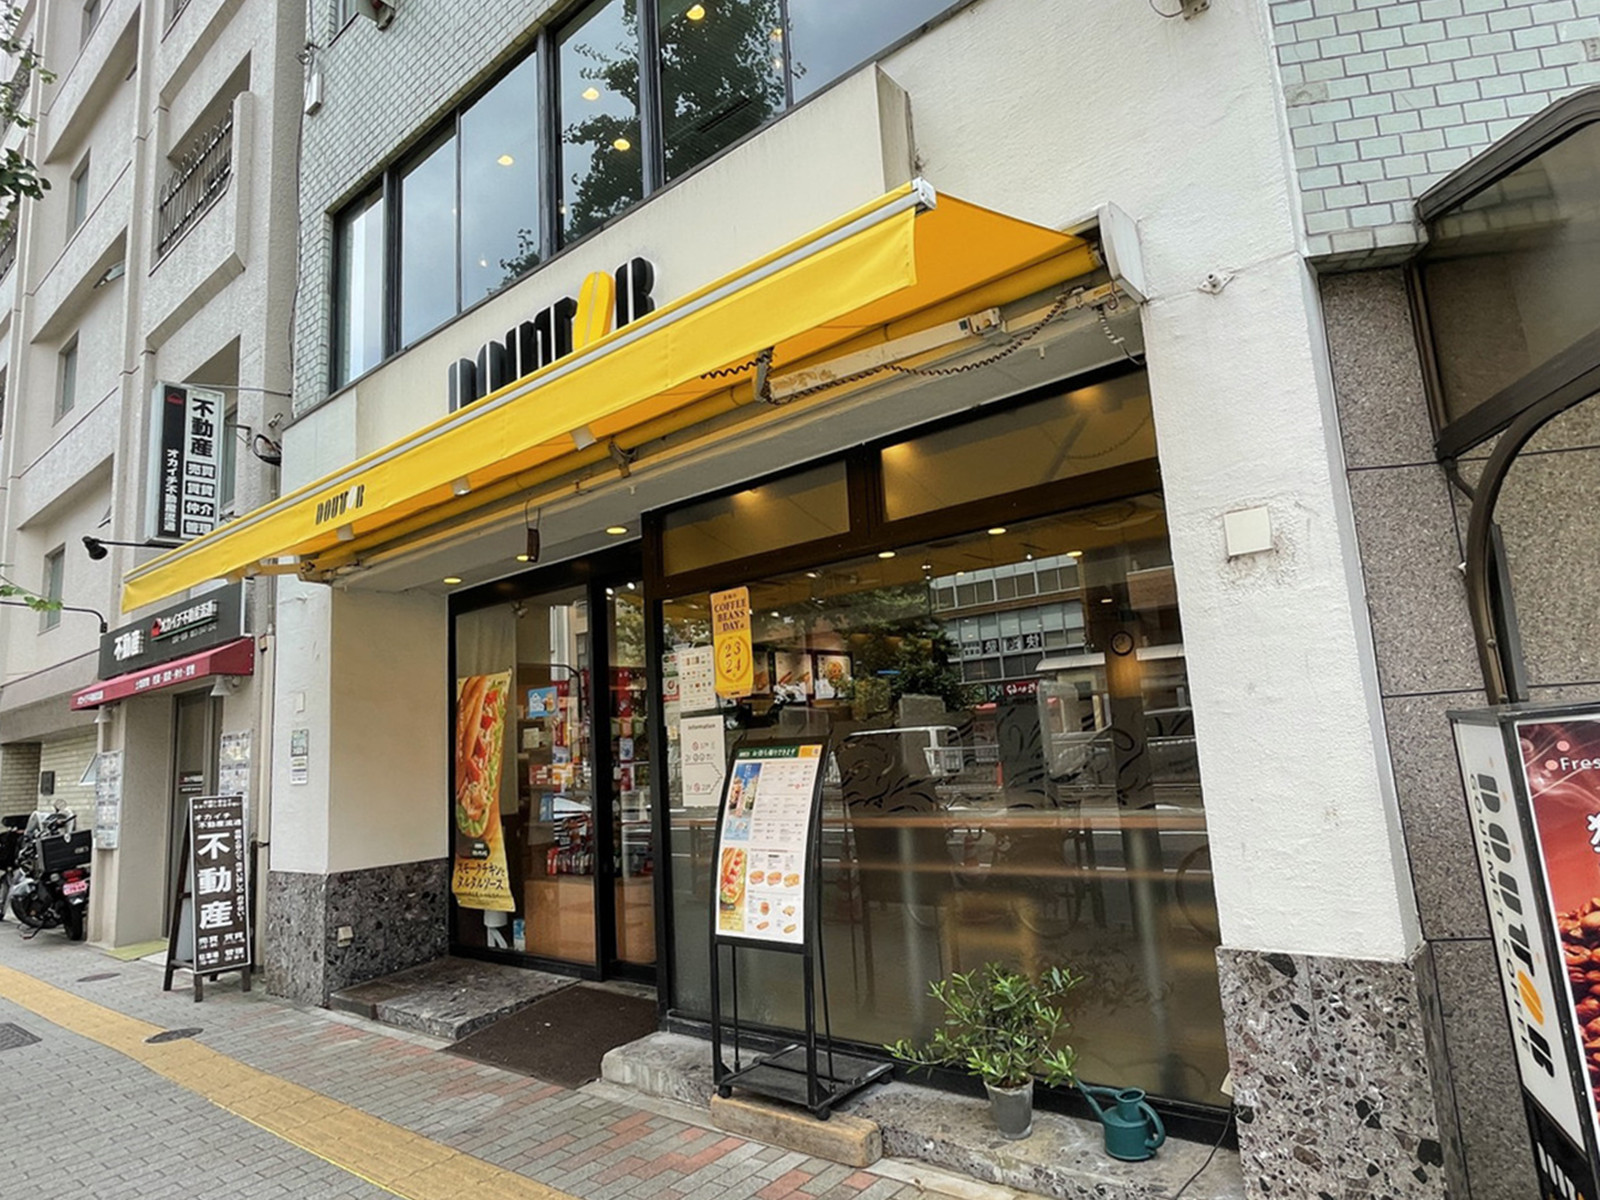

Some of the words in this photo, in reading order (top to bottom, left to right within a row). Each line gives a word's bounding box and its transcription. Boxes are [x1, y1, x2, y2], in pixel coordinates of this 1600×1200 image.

[447, 257, 656, 415] DOUTOR
[190, 397, 215, 458] 不動産
[186, 501, 213, 516] 仲介
[315, 485, 365, 526] DOUTOR
[714, 598, 746, 613] COFFEE
[717, 609, 746, 623] BEANS
[196, 832, 233, 931] 不動産
[1477, 774, 1555, 1078] DOUTOR
